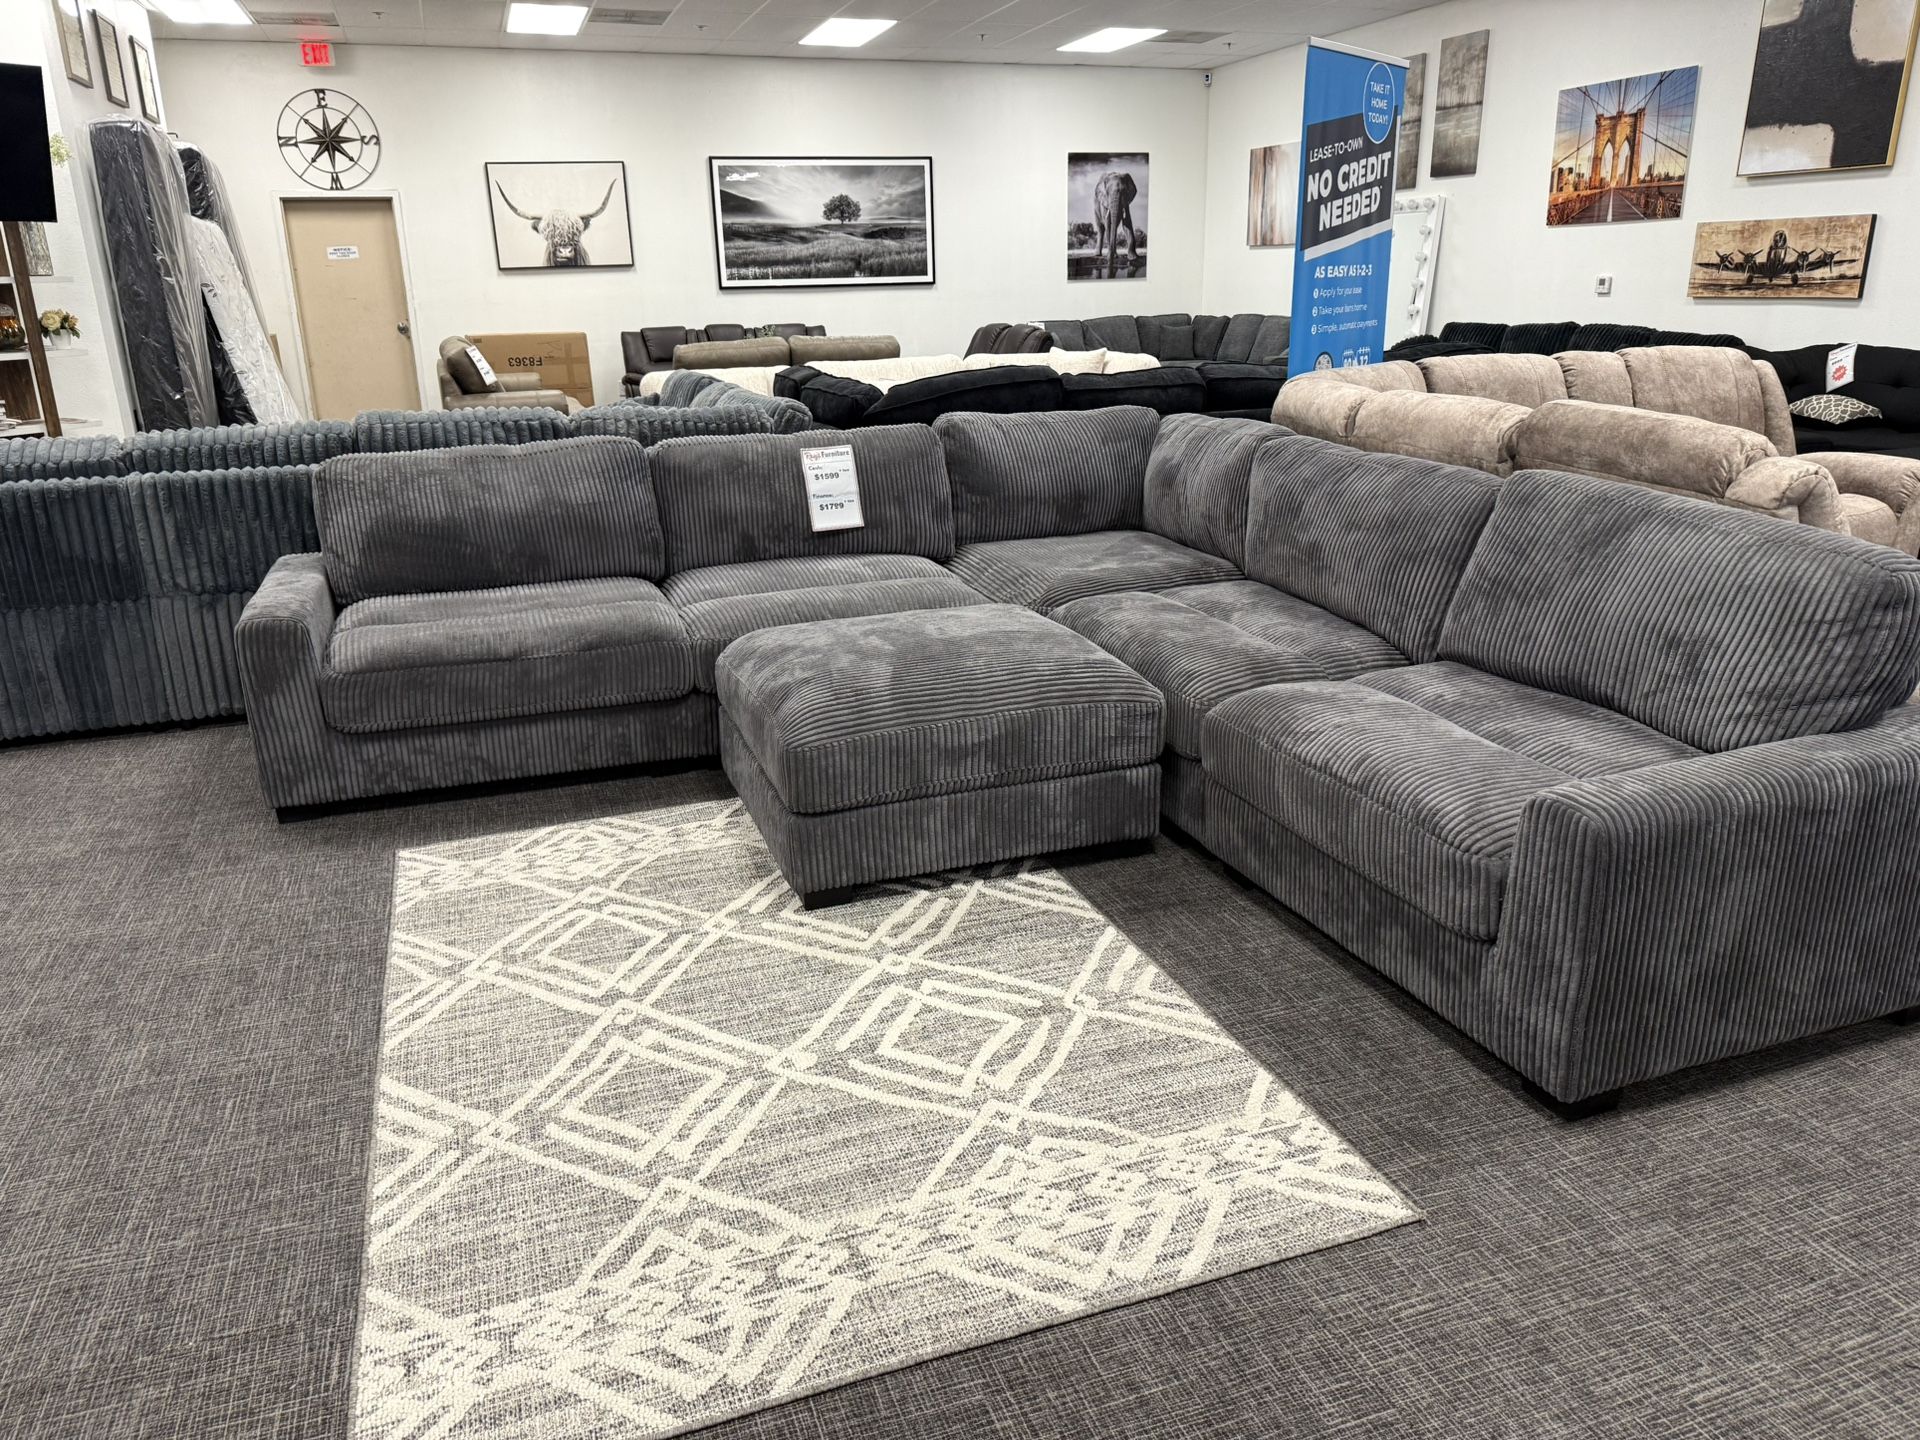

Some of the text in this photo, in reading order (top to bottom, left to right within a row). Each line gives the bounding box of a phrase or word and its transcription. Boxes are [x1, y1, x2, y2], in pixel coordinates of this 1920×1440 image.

[301, 43, 330, 65] EXIT
[1370, 82, 1391, 96] TAKE IT
[314, 89, 328, 108] E
[1371, 97, 1388, 110] HOME
[1368, 112, 1389, 125] TODAY!
[1309, 136, 1364, 163] LEASE-TO-OWN
[1307, 151, 1392, 203] NO CREDIT
[1314, 264, 1373, 279] AS EASY AS 1-2-3
[1319, 287, 1336, 298] Apply
[1336, 286, 1344, 296] for
[1318, 305, 1332, 316] Take
[1332, 306, 1343, 316] your
[508, 356, 543, 367] F8363
[821, 450, 850, 458] Furniture
[814, 472, 840, 481] $1599
[819, 502, 845, 511] $1799
